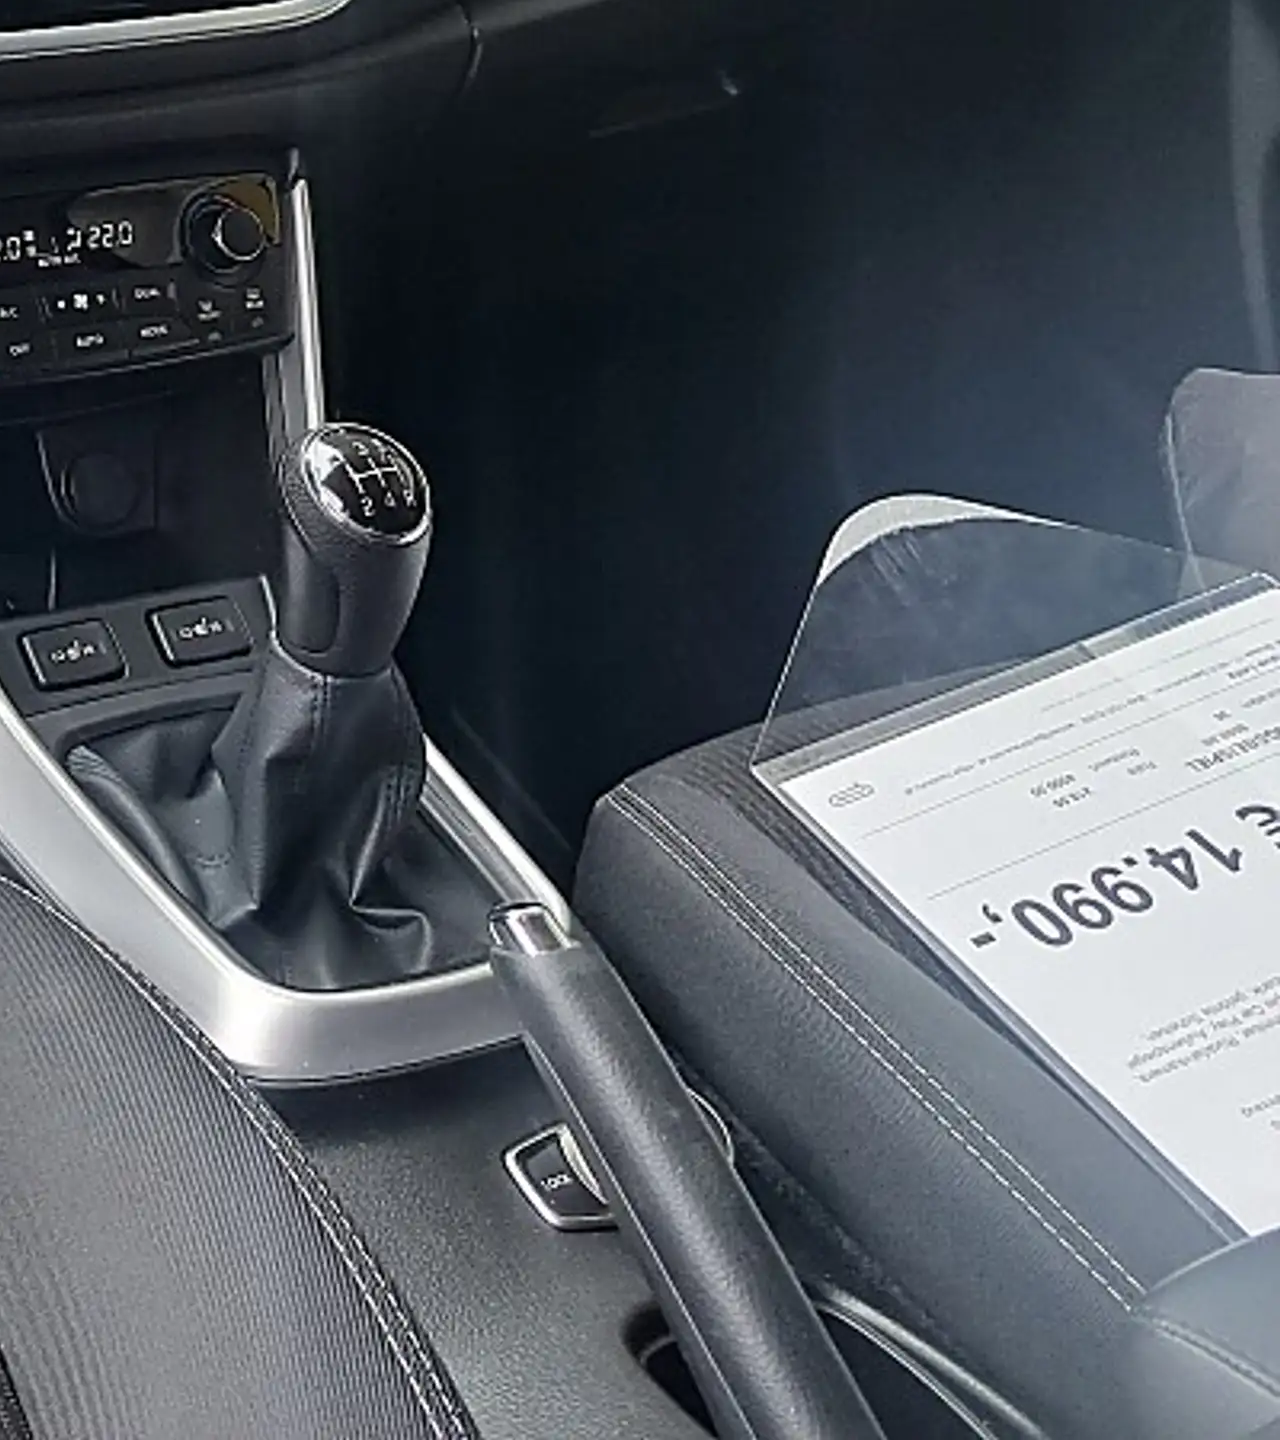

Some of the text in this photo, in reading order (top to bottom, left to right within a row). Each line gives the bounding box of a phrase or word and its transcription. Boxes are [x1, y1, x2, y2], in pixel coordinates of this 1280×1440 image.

[88, 220, 133, 249] 22.0
[360, 495, 376, 518] 2
[970, 829, 1242, 947] 14.990,-
